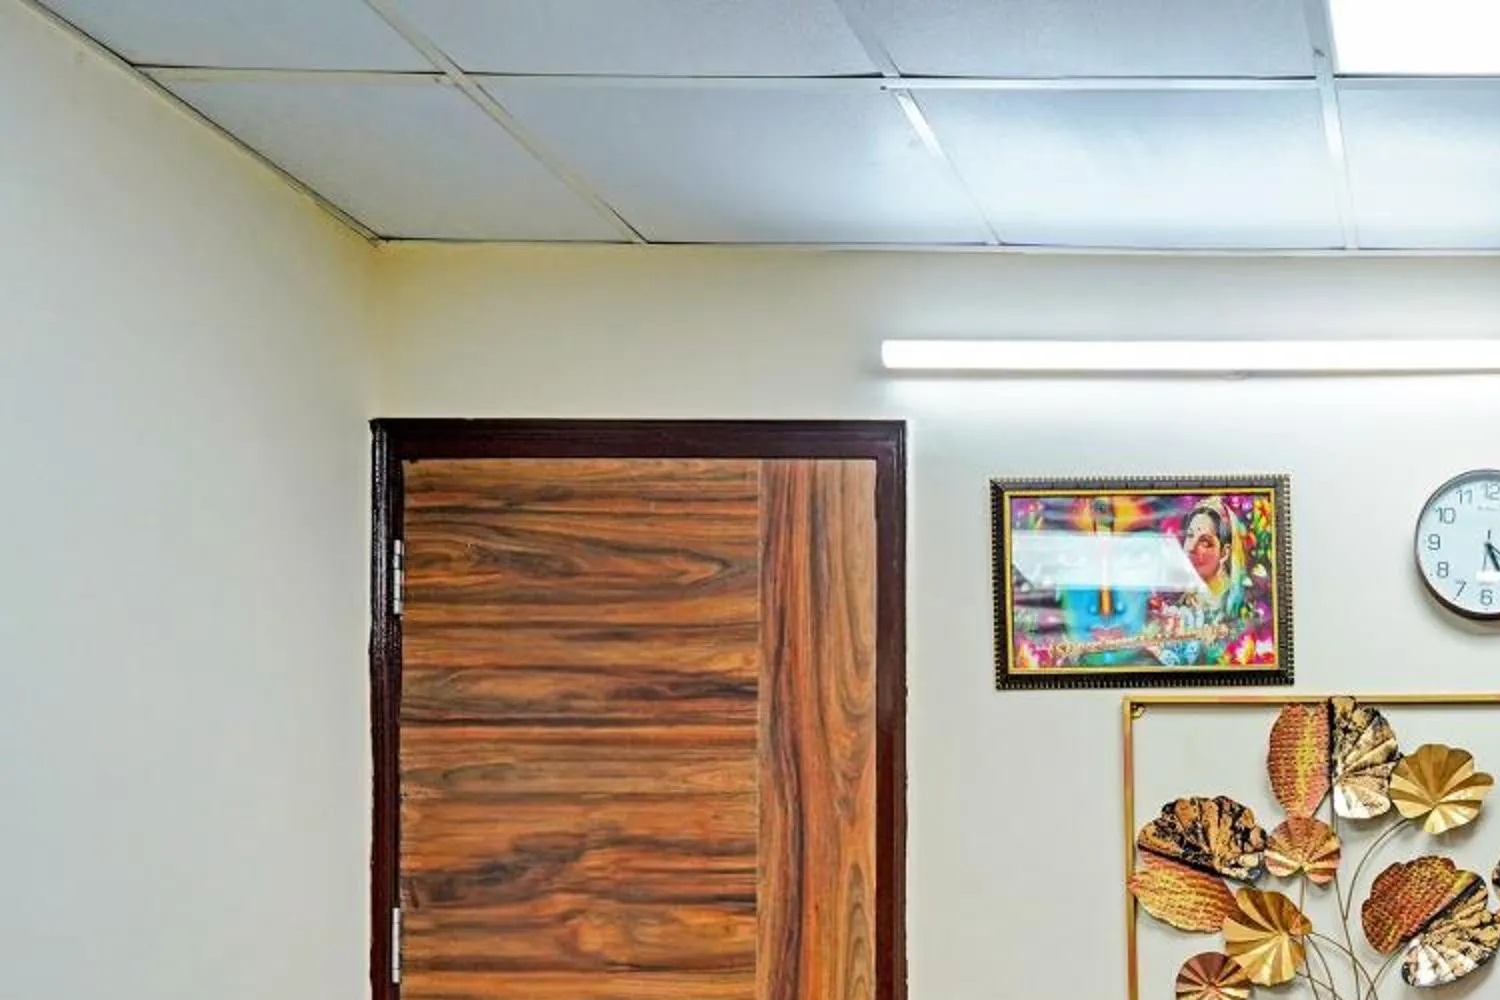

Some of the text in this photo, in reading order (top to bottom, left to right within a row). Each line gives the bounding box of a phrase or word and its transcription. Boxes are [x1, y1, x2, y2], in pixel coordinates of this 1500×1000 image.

[1456, 490, 1473, 505] 11
[1485, 483, 1500, 500] 12
[1435, 507, 1456, 524] 10
[1427, 533, 1441, 550] 9
[1436, 562, 1449, 578] 8
[1455, 581, 1467, 599] 7
[1480, 589, 1493, 606] 6
